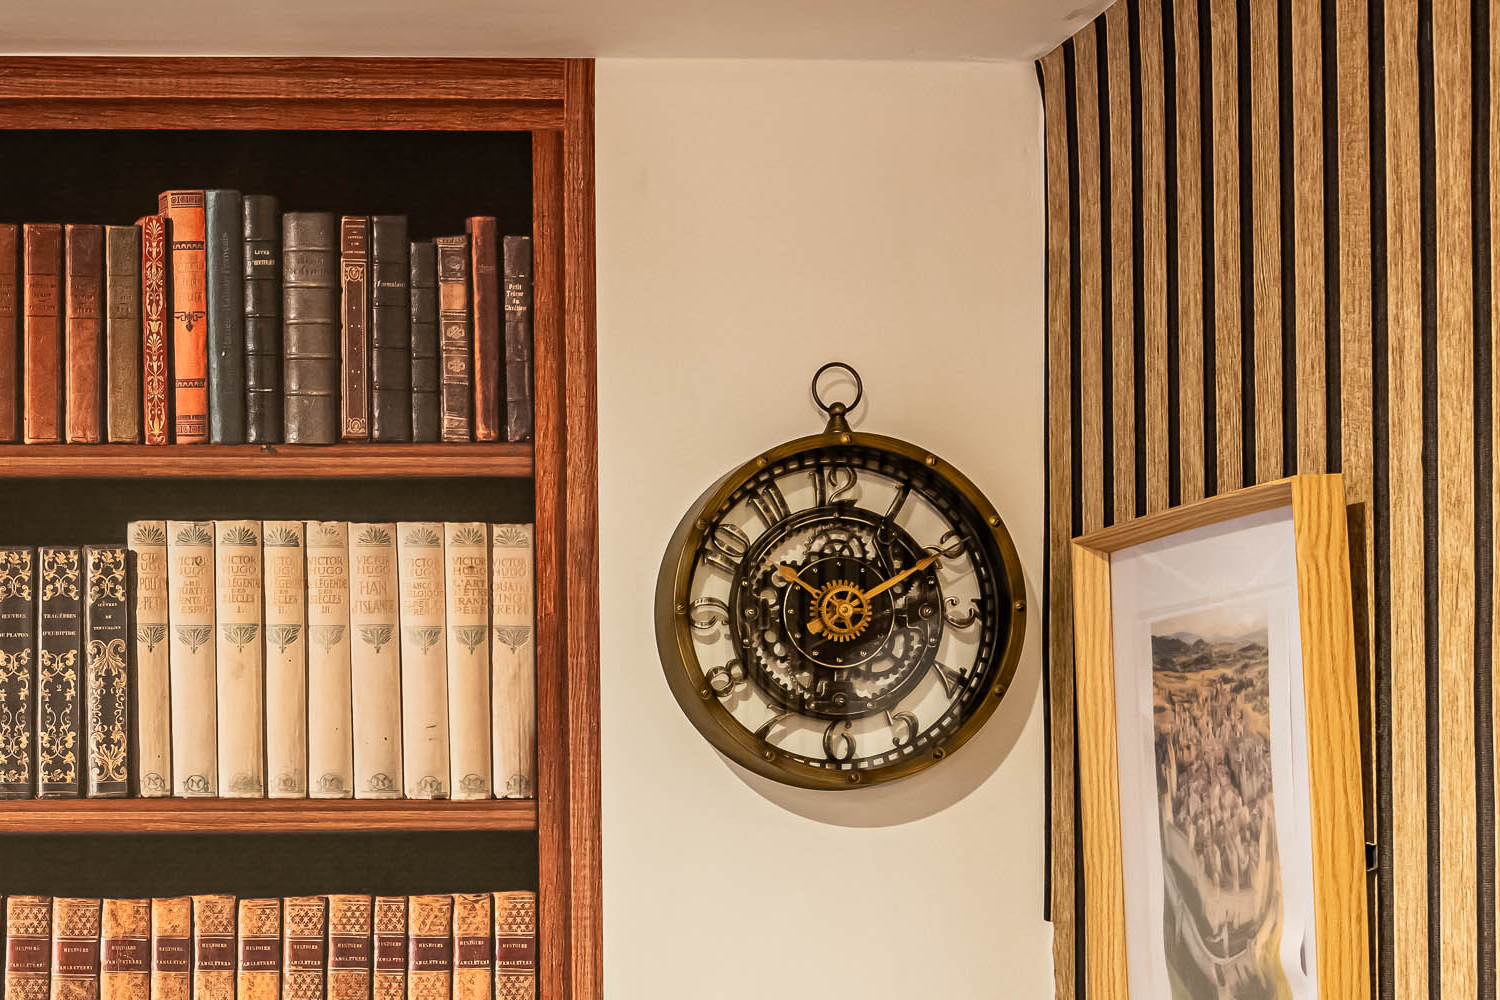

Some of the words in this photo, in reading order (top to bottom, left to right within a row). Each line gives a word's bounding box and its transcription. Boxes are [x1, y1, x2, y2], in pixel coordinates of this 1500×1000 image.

[809, 466, 859, 507] 12
[823, 718, 857, 761] 6
[886, 708, 919, 748] 5
